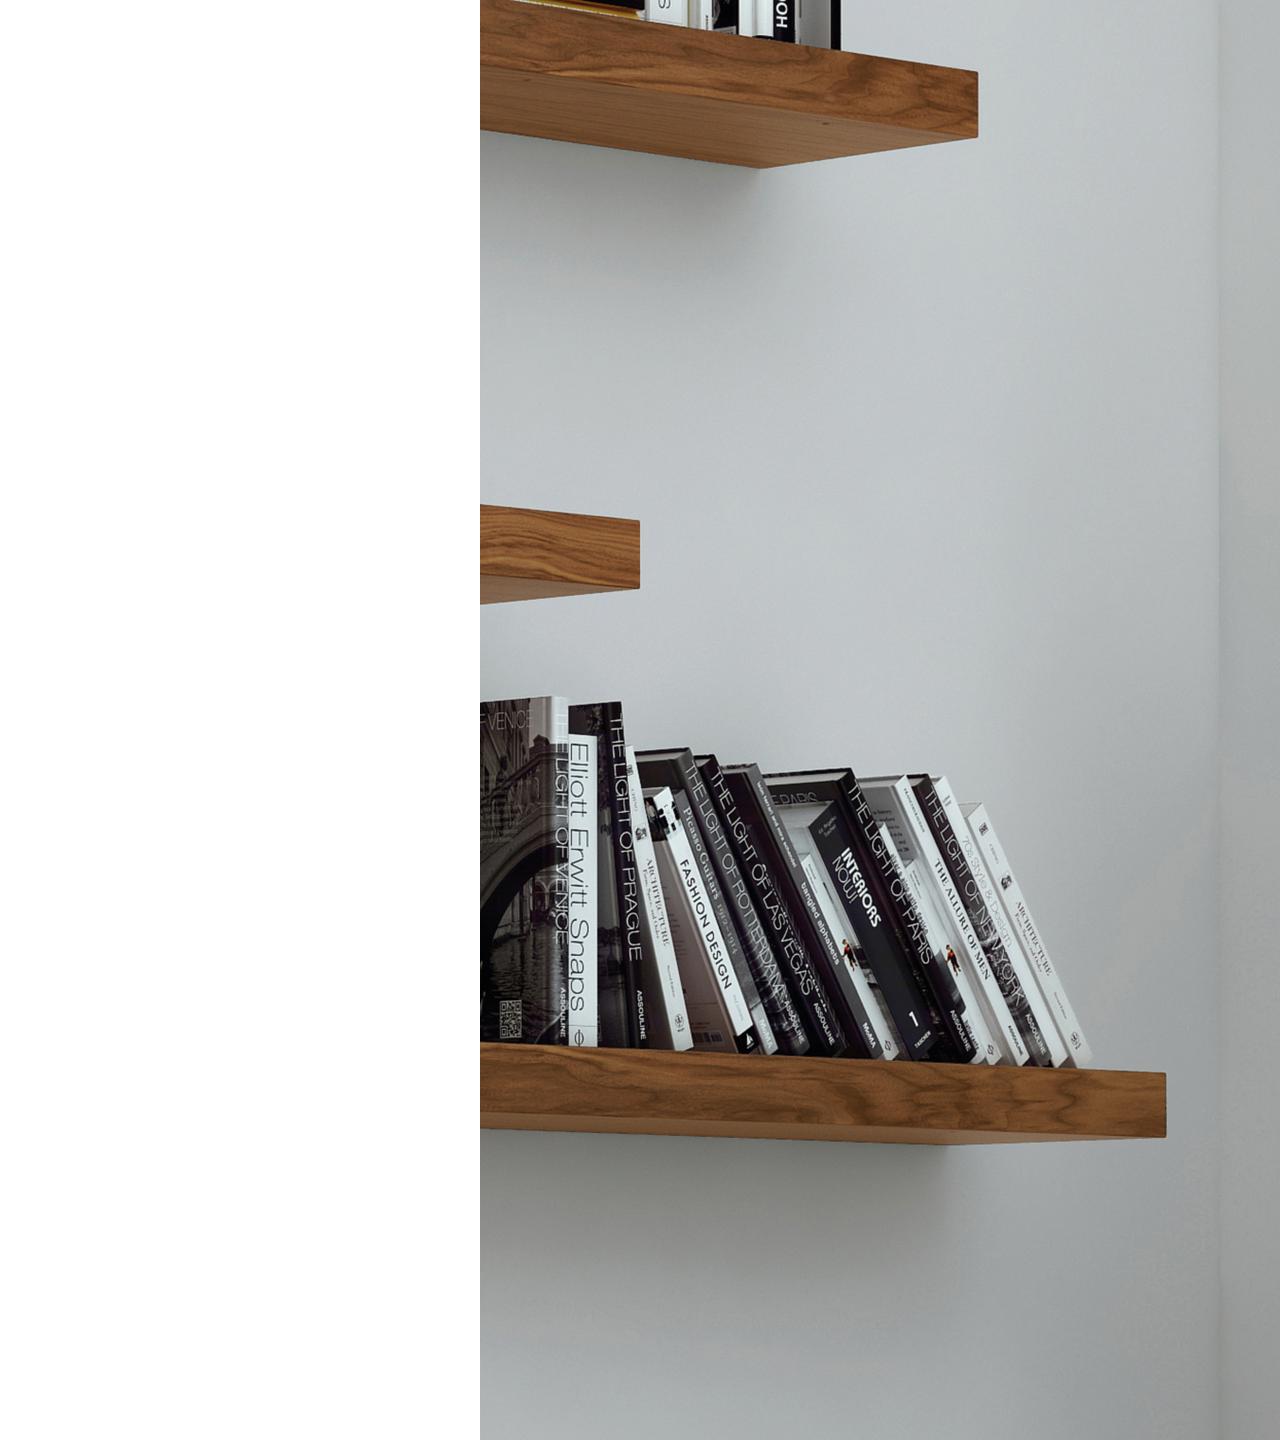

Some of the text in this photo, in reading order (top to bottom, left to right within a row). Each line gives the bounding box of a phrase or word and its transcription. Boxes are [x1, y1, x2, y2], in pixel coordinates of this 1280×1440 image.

[569, 743, 589, 1011] Elliott Erwitt Snaps
[680, 859, 732, 990] FASHION DESIGN
[832, 856, 857, 904] NOW!
[841, 847, 882, 928] INTERIORS
[935, 858, 990, 980] THE ALLURE OF MEN
[909, 1011, 919, 1027] 1
